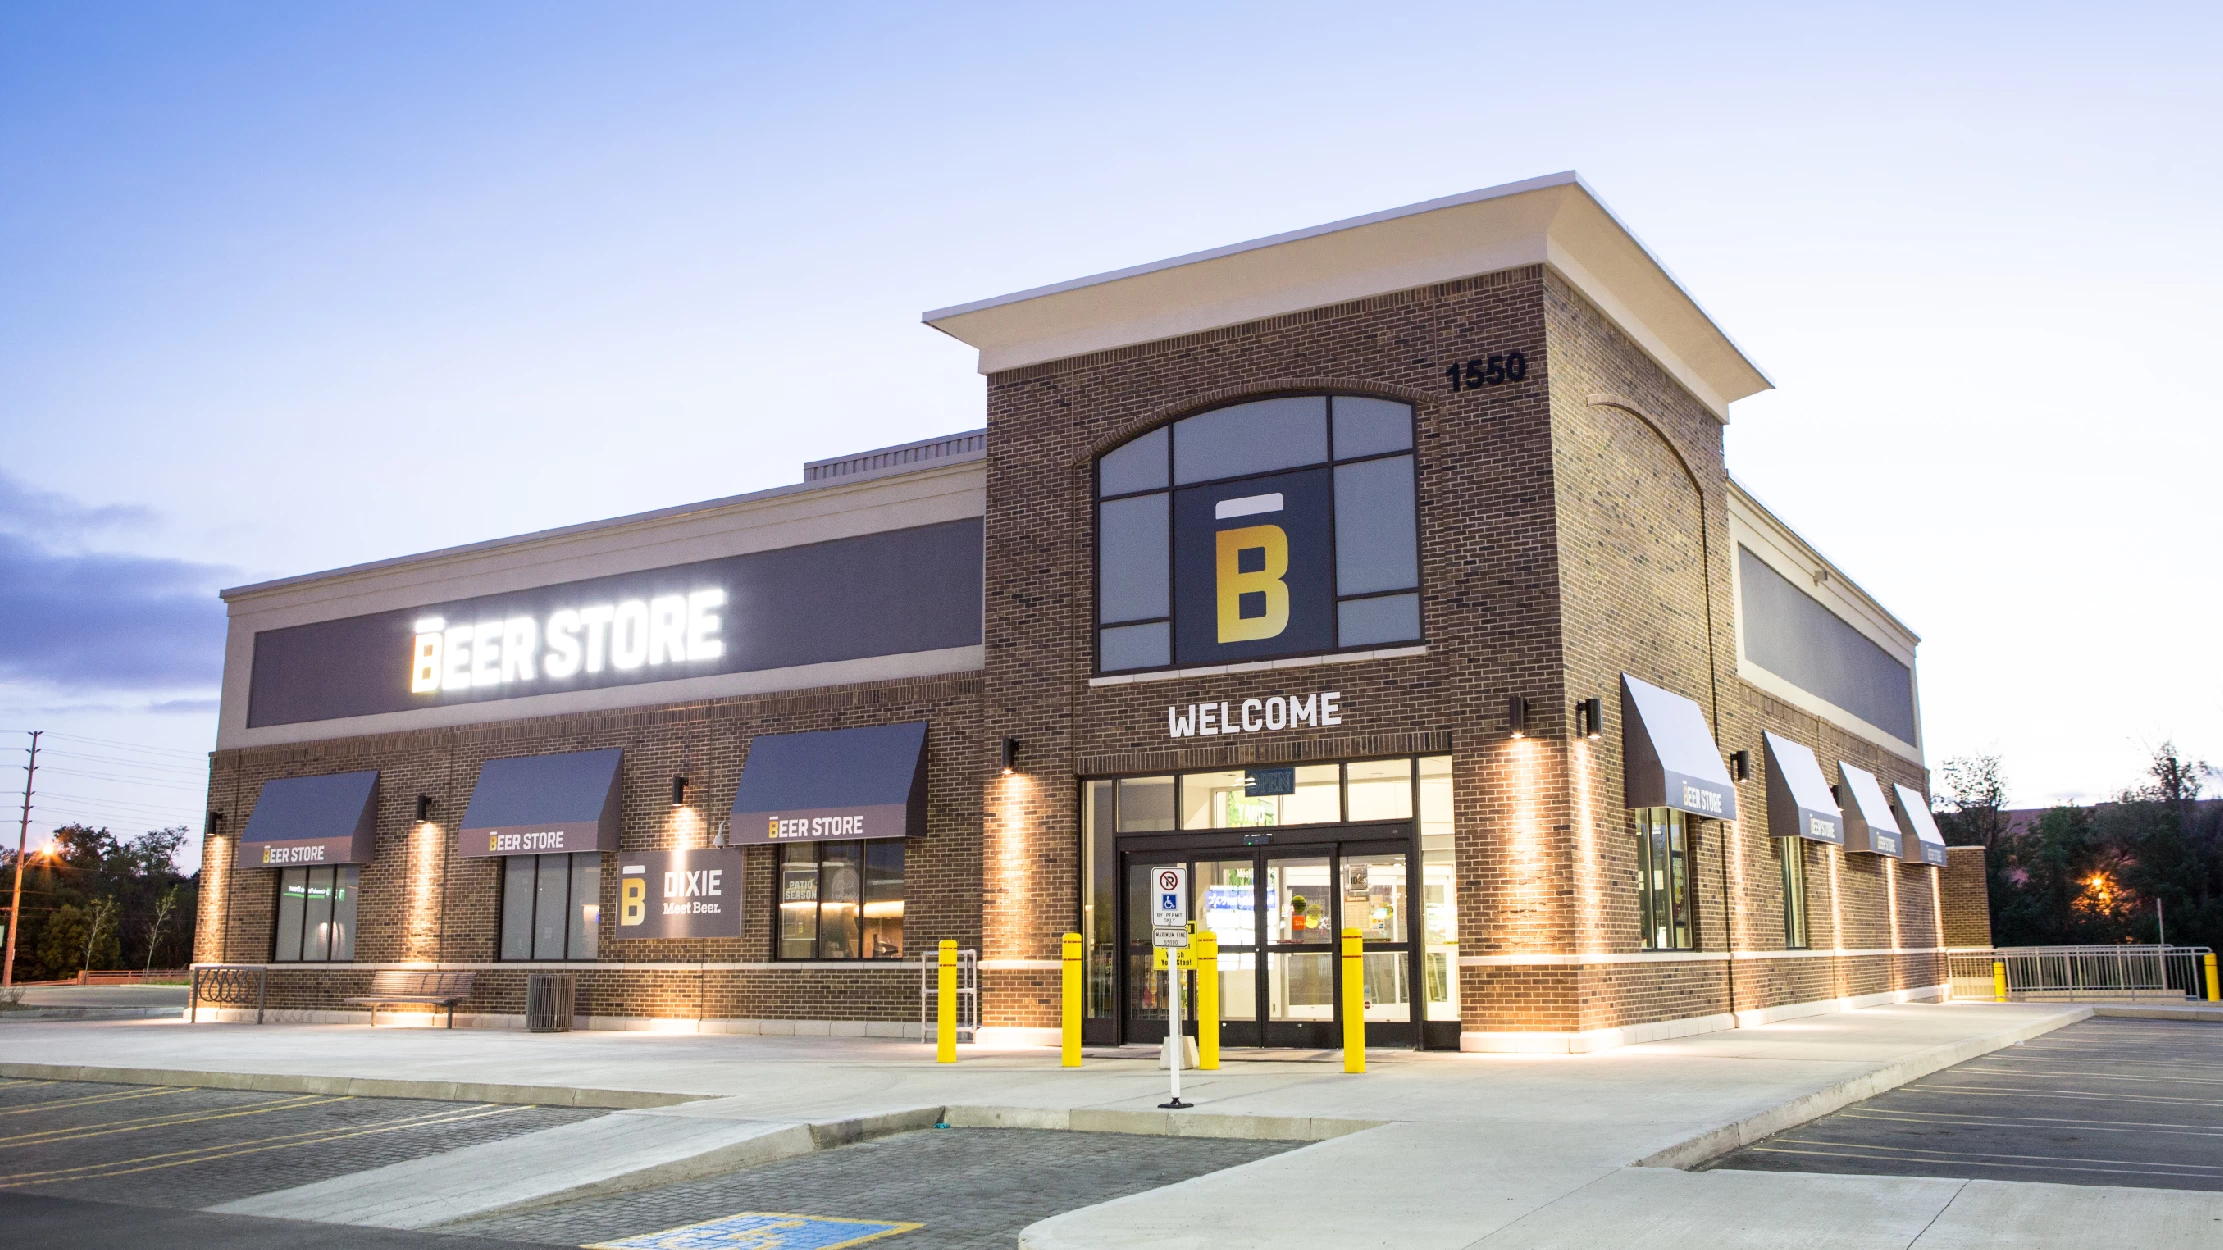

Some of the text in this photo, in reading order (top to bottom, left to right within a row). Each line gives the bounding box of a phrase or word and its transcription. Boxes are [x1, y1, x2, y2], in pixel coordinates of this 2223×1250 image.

[1446, 353, 1526, 392] 1550
[1215, 493, 1290, 644] B
[411, 589, 725, 693] BEER STORE
[1169, 692, 1342, 738] WELCOME
[1248, 772, 1292, 794] OPEN
[1683, 780, 1722, 813] BEER STORE
[769, 816, 864, 838] BEER STORE
[489, 831, 564, 851] BEER STORE
[262, 845, 325, 864] BEER STORE
[786, 889, 817, 899] SEASON
[789, 880, 813, 889] PATIO
[621, 866, 723, 926] B DIXIE
[663, 902, 691, 914] Meet
